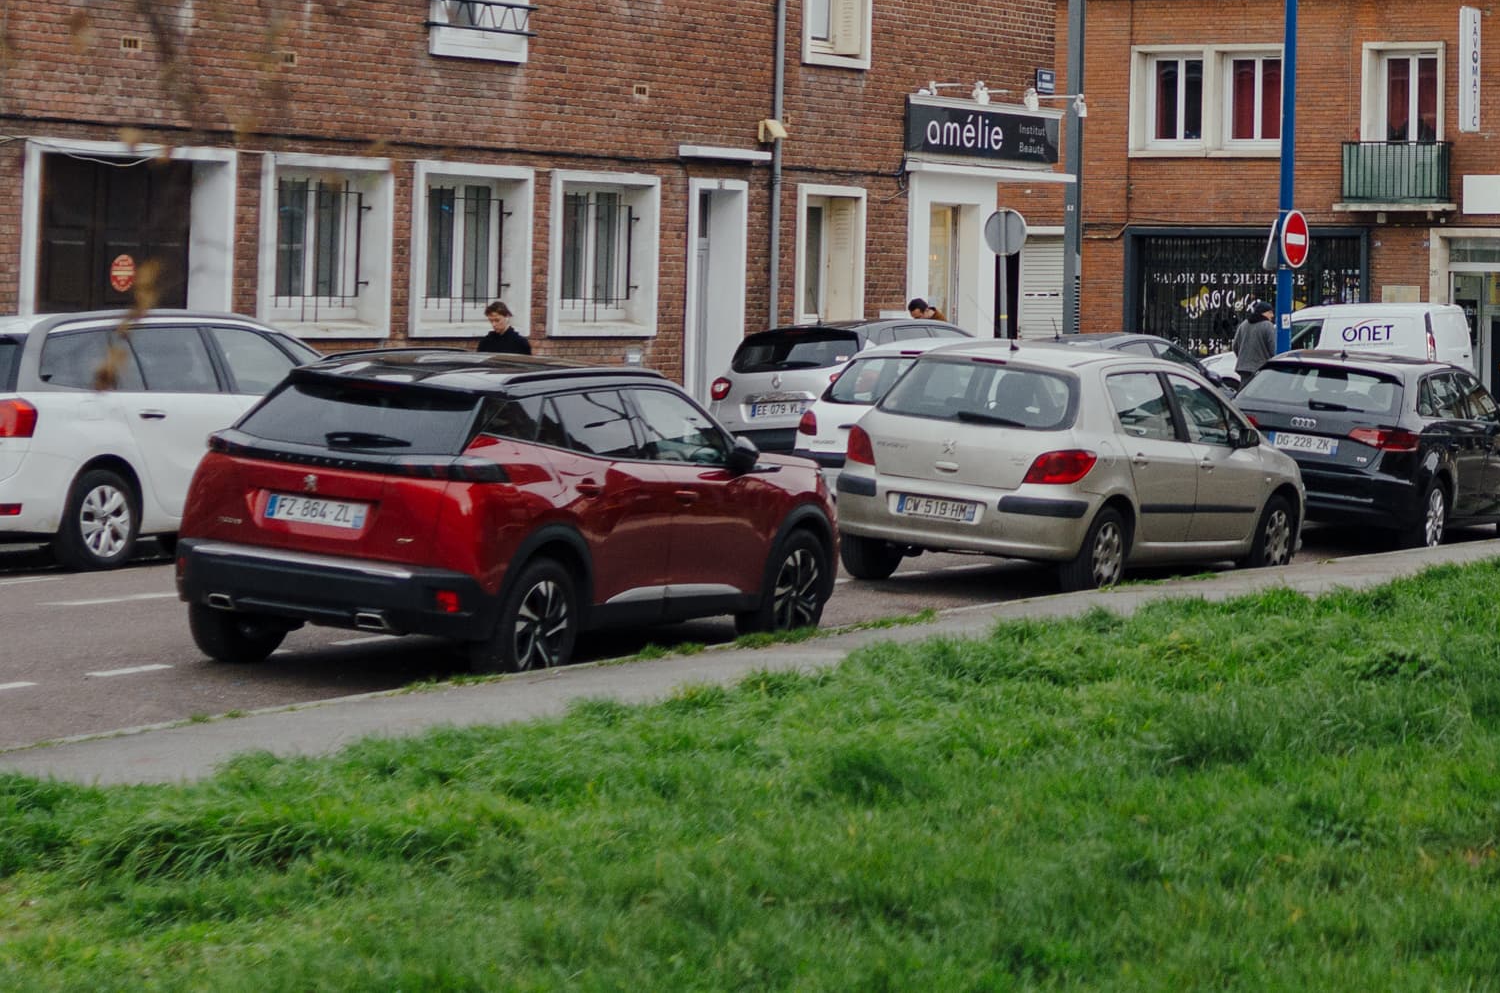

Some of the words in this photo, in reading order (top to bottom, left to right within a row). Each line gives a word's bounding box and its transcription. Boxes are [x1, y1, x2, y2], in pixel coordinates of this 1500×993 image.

[1471, 13, 1479, 127] LAVOMATIC
[927, 114, 1003, 150] amélie
[1019, 123, 1046, 136] Institut
[1019, 142, 1045, 155] Beauté
[1200, 273, 1217, 284] DE
[1342, 324, 1394, 342] ONET
